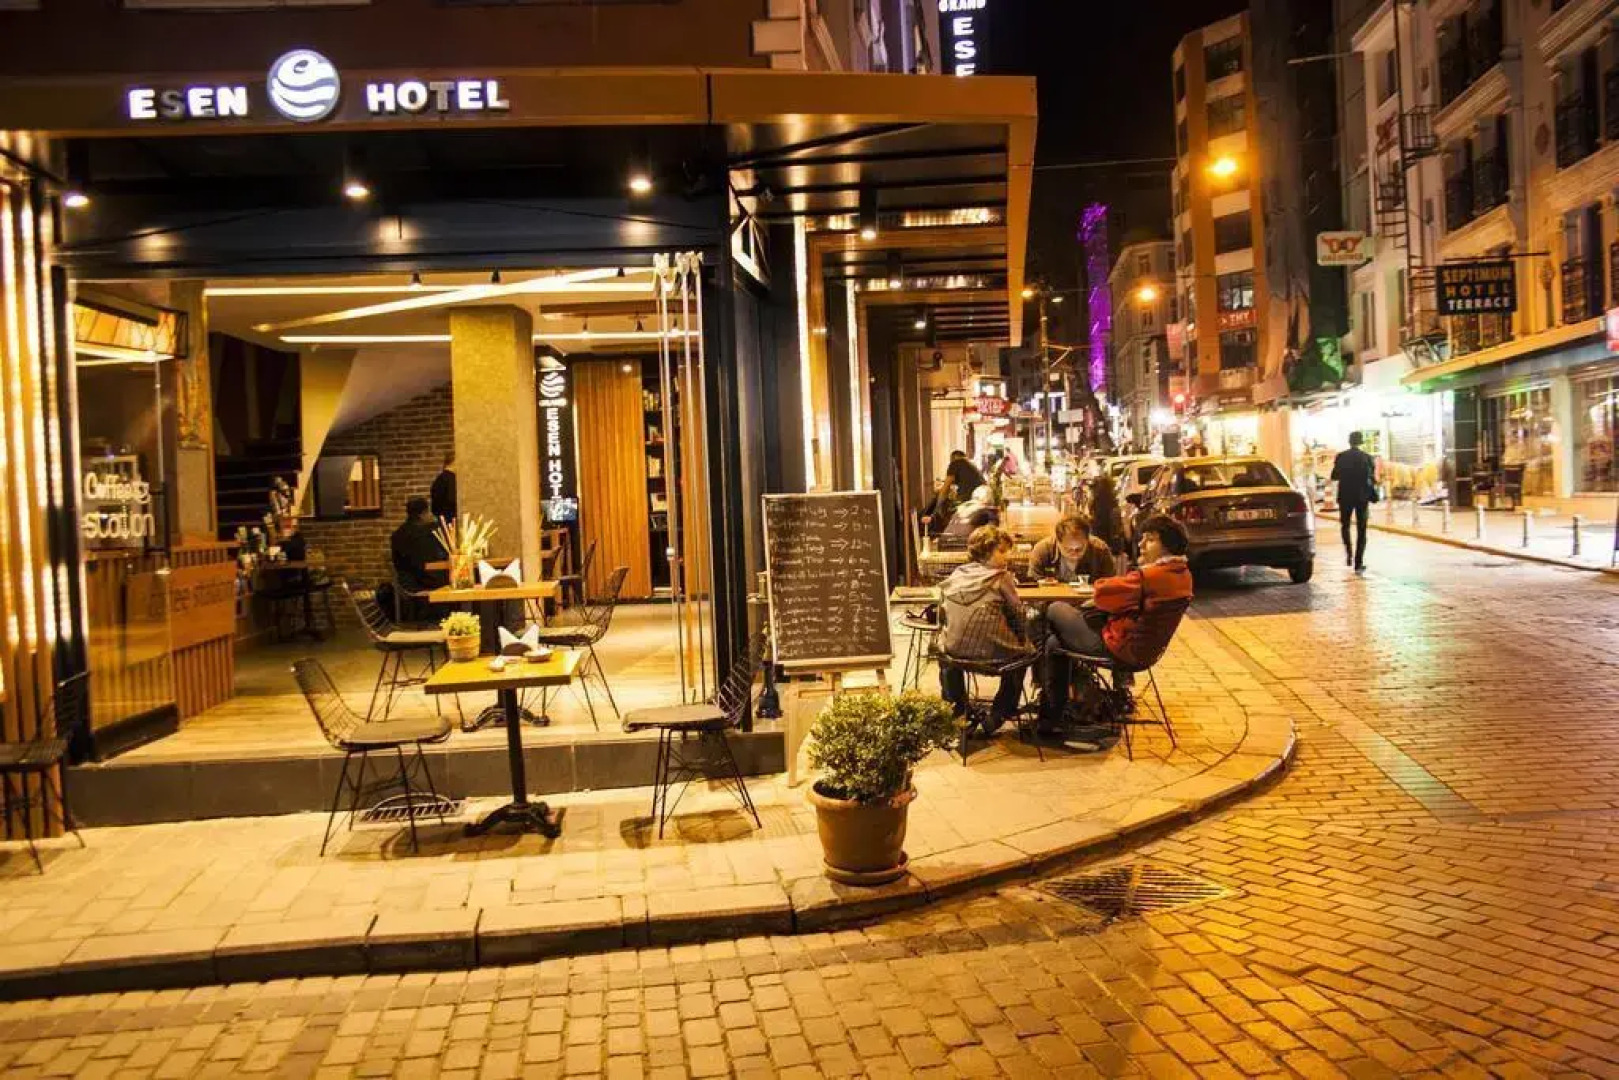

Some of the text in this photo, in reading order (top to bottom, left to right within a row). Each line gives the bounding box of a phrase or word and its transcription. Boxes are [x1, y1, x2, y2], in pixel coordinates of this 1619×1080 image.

[128, 80, 510, 119] ESEN HOTEL
[1445, 283, 1509, 298] HOTEL
[1447, 297, 1511, 311] TERRACE
[546, 407, 561, 456] ESEN
